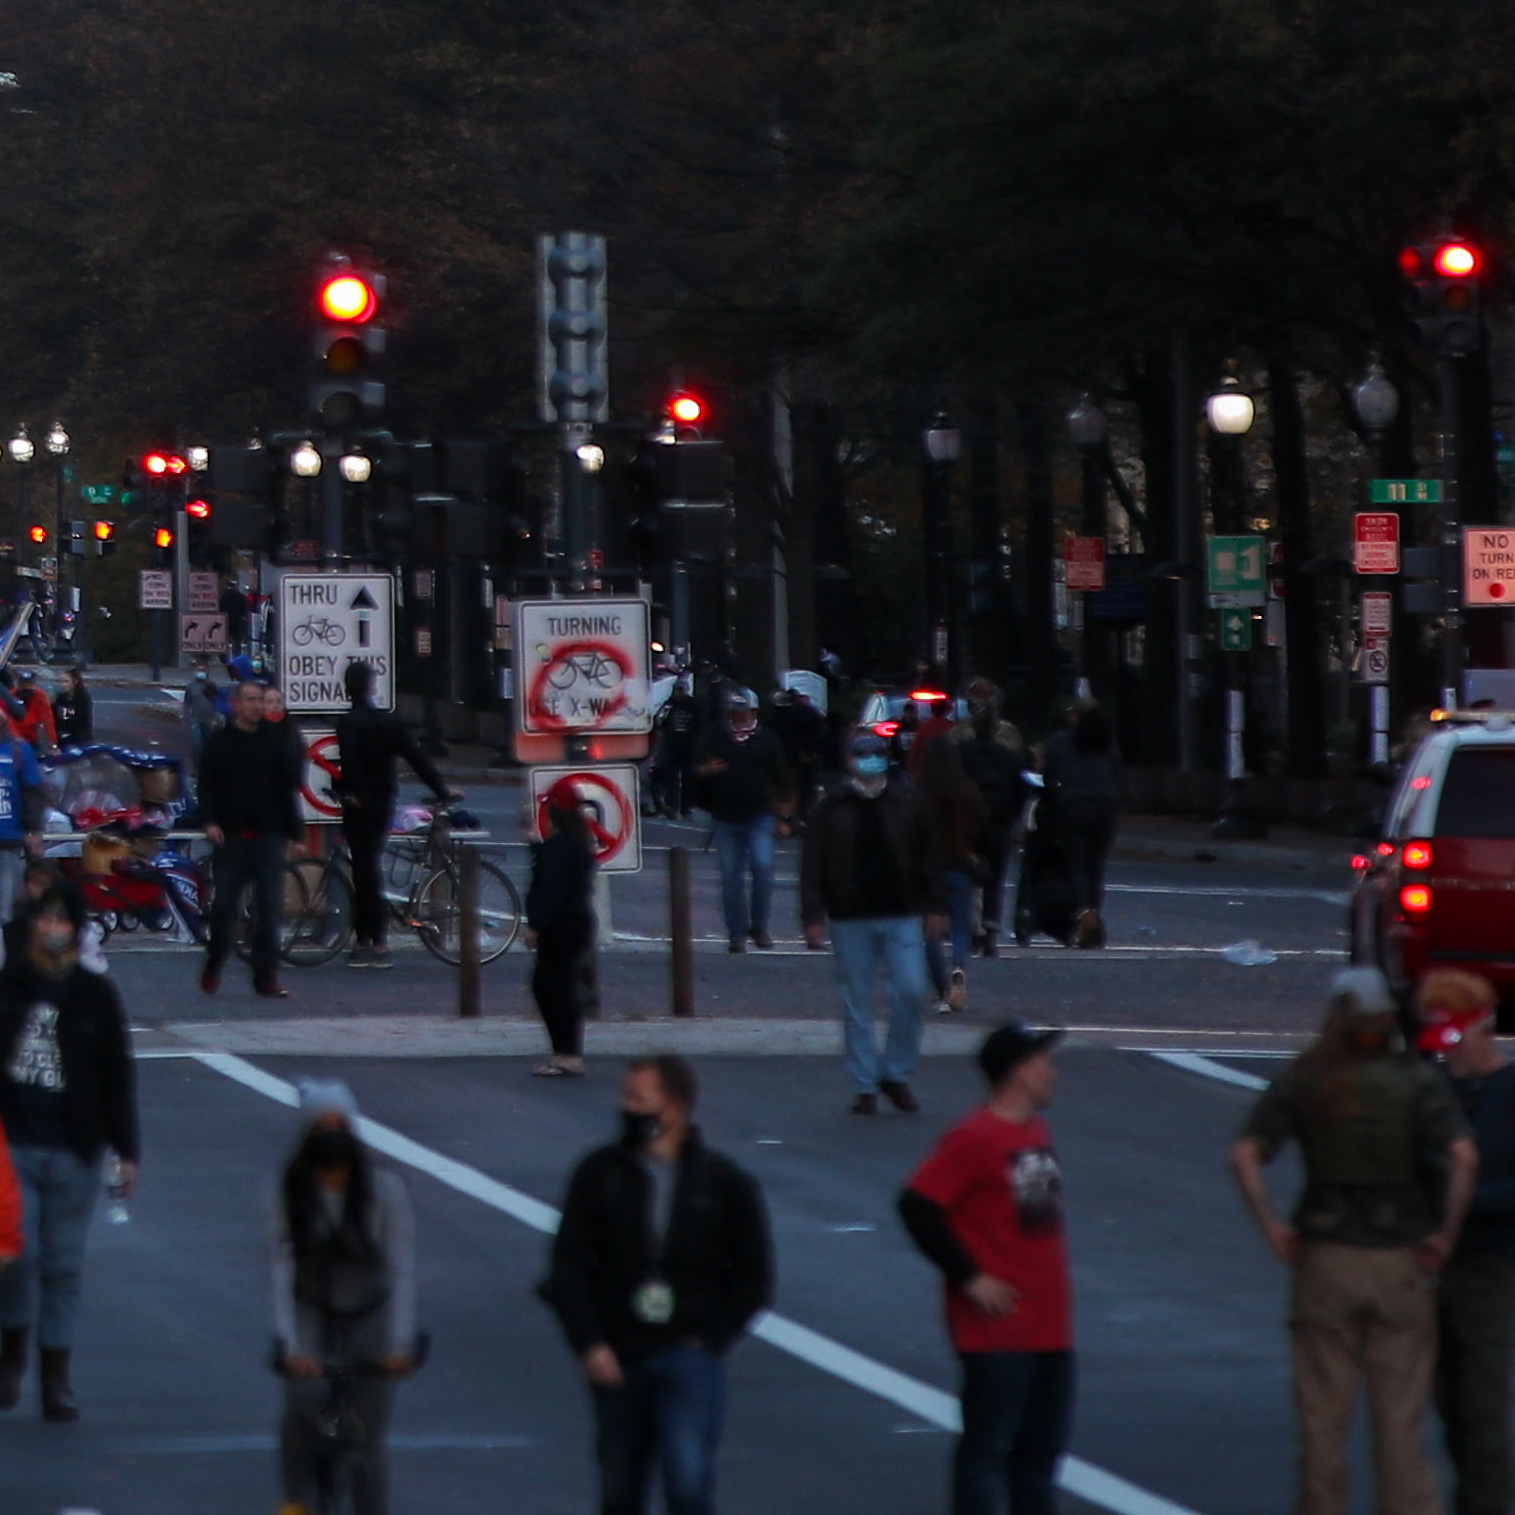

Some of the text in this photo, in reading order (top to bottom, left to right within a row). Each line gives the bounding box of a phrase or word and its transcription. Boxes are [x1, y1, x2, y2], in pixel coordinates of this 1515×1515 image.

[1485, 536, 1509, 548] NO
[1481, 553, 1514, 564] TURN
[1473, 568, 1490, 579] ON
[290, 585, 338, 605] THRU
[548, 616, 622, 636] TURNING
[290, 656, 337, 676] OBEY
